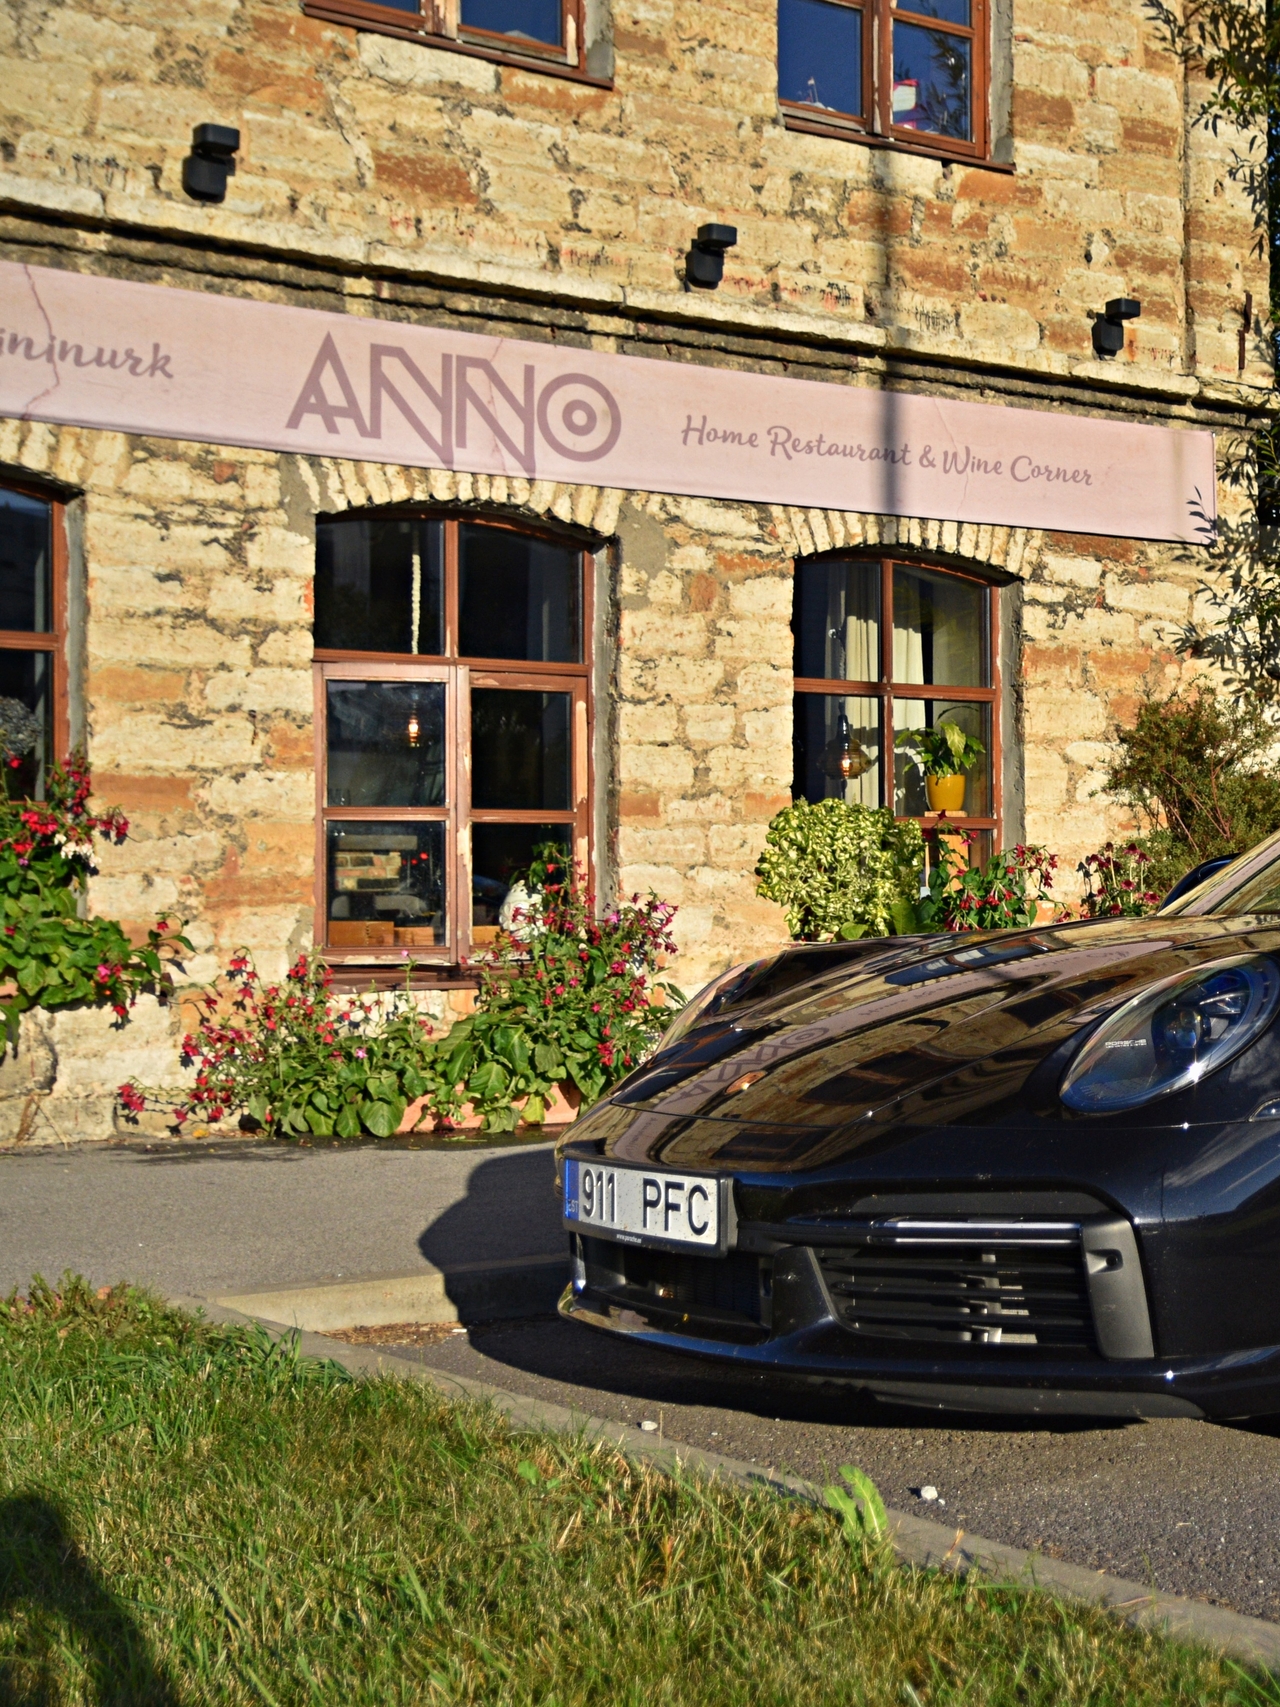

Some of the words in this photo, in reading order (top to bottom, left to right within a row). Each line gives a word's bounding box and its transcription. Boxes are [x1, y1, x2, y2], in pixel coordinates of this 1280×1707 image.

[287, 331, 622, 480] ANNO
[681, 414, 759, 447] Home
[766, 424, 912, 466] Restaurant
[918, 444, 937, 469] &
[942, 445, 1003, 476] Wine
[1010, 454, 1093, 487] Corner
[583, 1168, 617, 1223] 911
[642, 1177, 710, 1236] PFC
